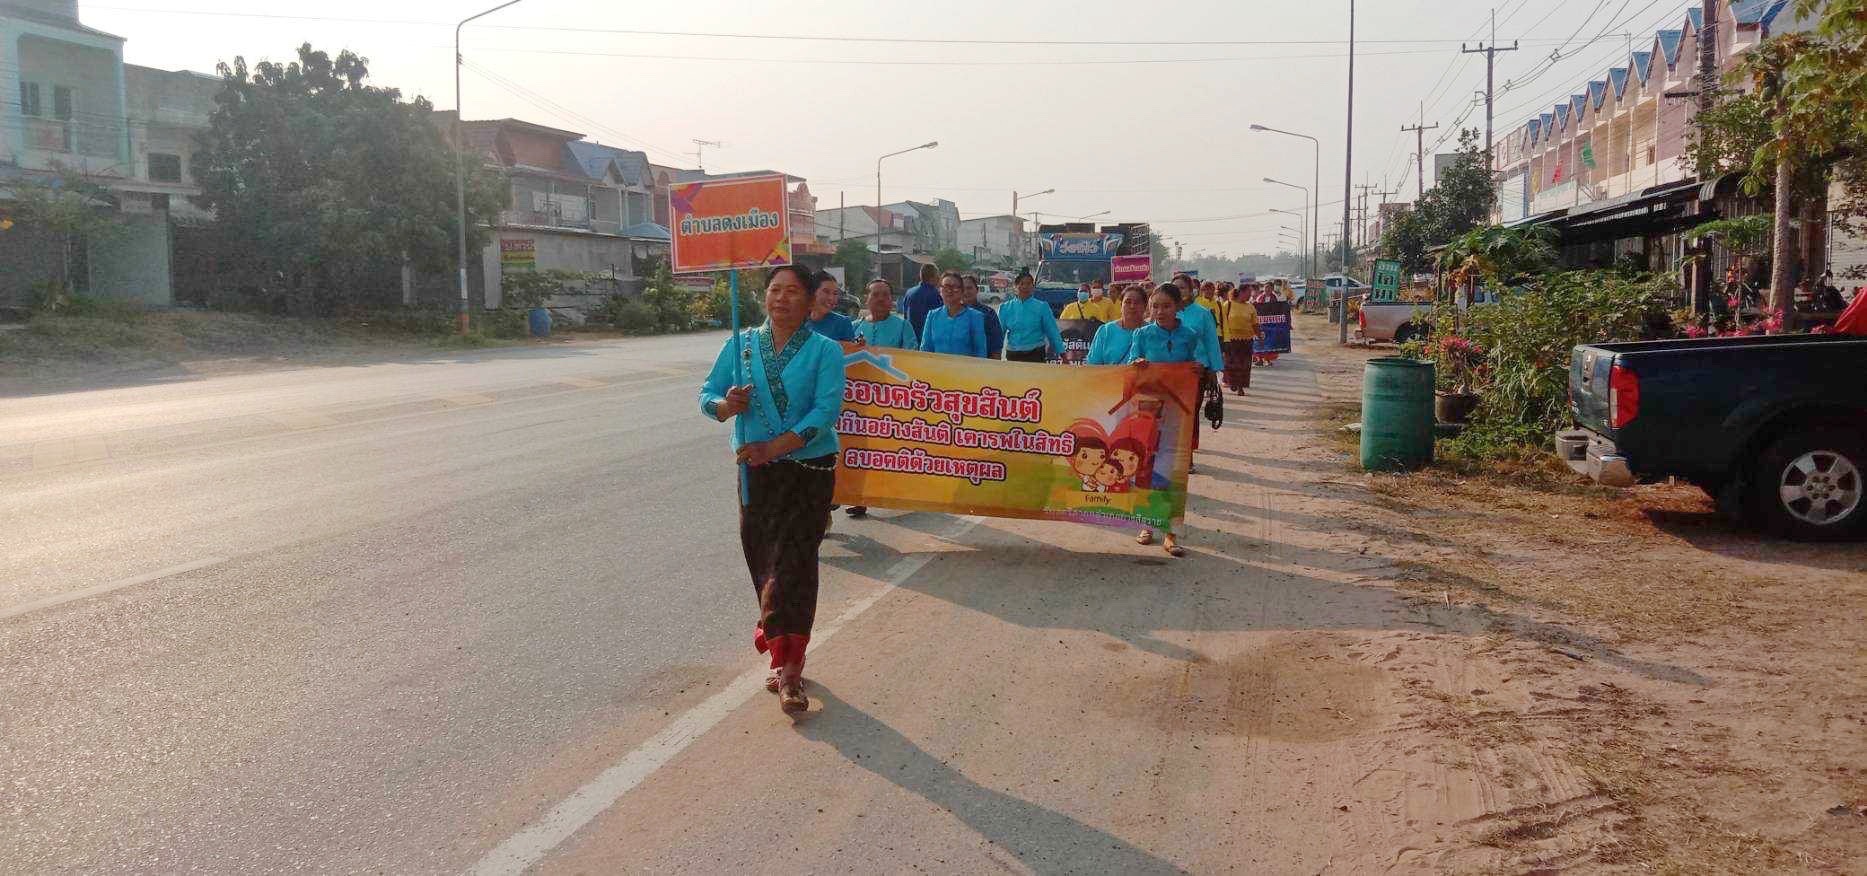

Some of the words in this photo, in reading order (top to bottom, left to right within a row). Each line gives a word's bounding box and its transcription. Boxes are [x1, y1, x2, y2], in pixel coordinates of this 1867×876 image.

[681, 207, 779, 235] ตำบลดงเมือง
[954, 428, 1076, 455] เคารพในสิทธิ
[845, 448, 1006, 485] ลบอคติด้วยเหตุผล
